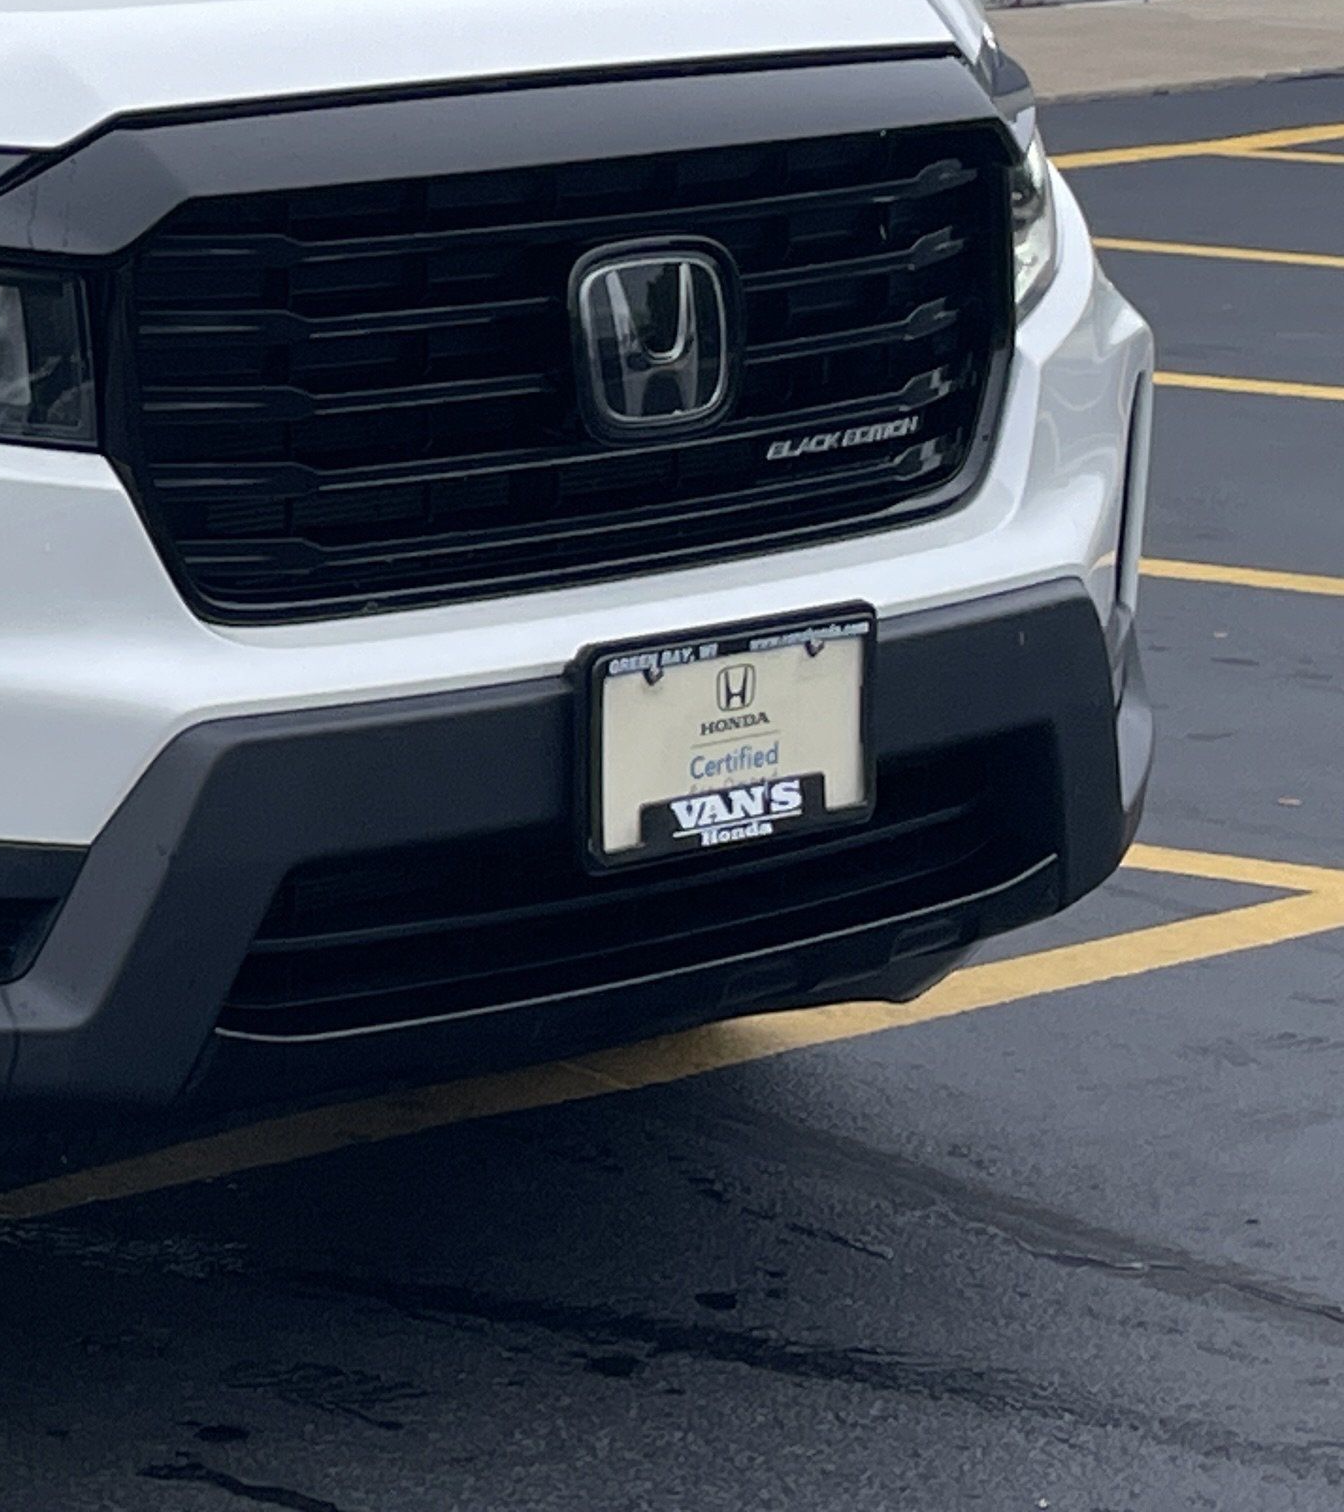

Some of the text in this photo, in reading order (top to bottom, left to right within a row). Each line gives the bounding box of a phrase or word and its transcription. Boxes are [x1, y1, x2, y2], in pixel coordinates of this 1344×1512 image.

[766, 415, 919, 461] BLACK EDITION
[699, 711, 770, 736] HONDA
[690, 742, 780, 780] Certified
[700, 819, 773, 847] Honda
